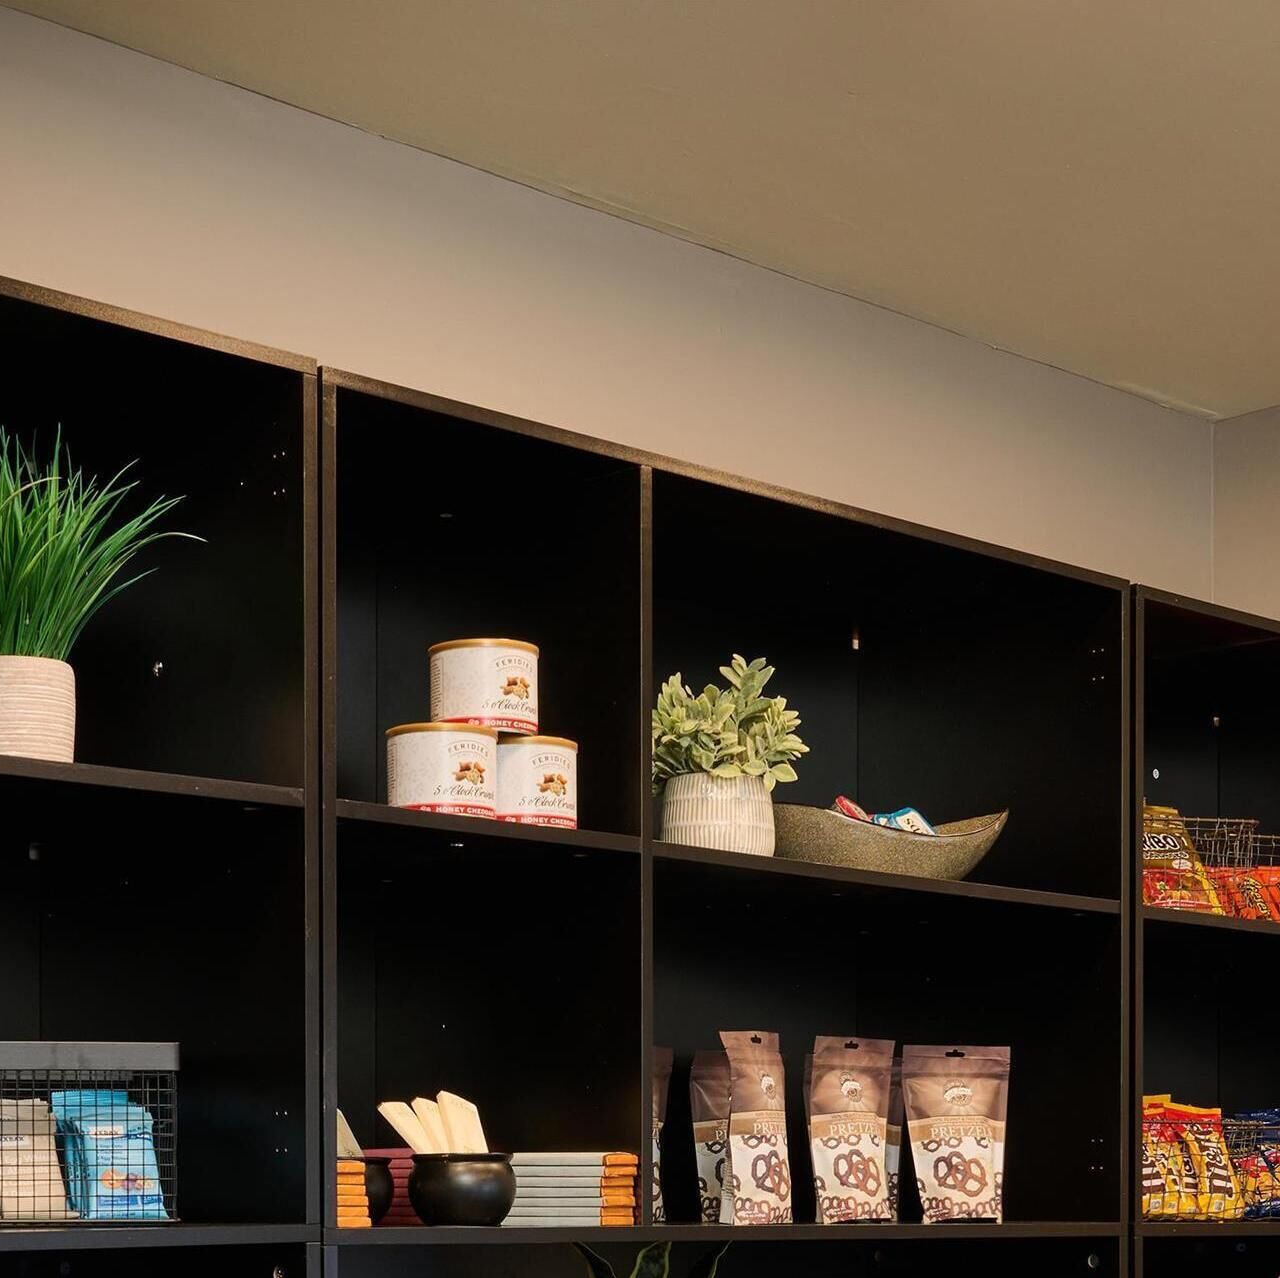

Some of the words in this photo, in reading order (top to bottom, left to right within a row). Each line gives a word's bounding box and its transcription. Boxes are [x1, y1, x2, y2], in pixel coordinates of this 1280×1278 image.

[484, 718, 512, 727] HONEY
[435, 805, 464, 814] HONEY
[521, 816, 549, 825] HONEY
